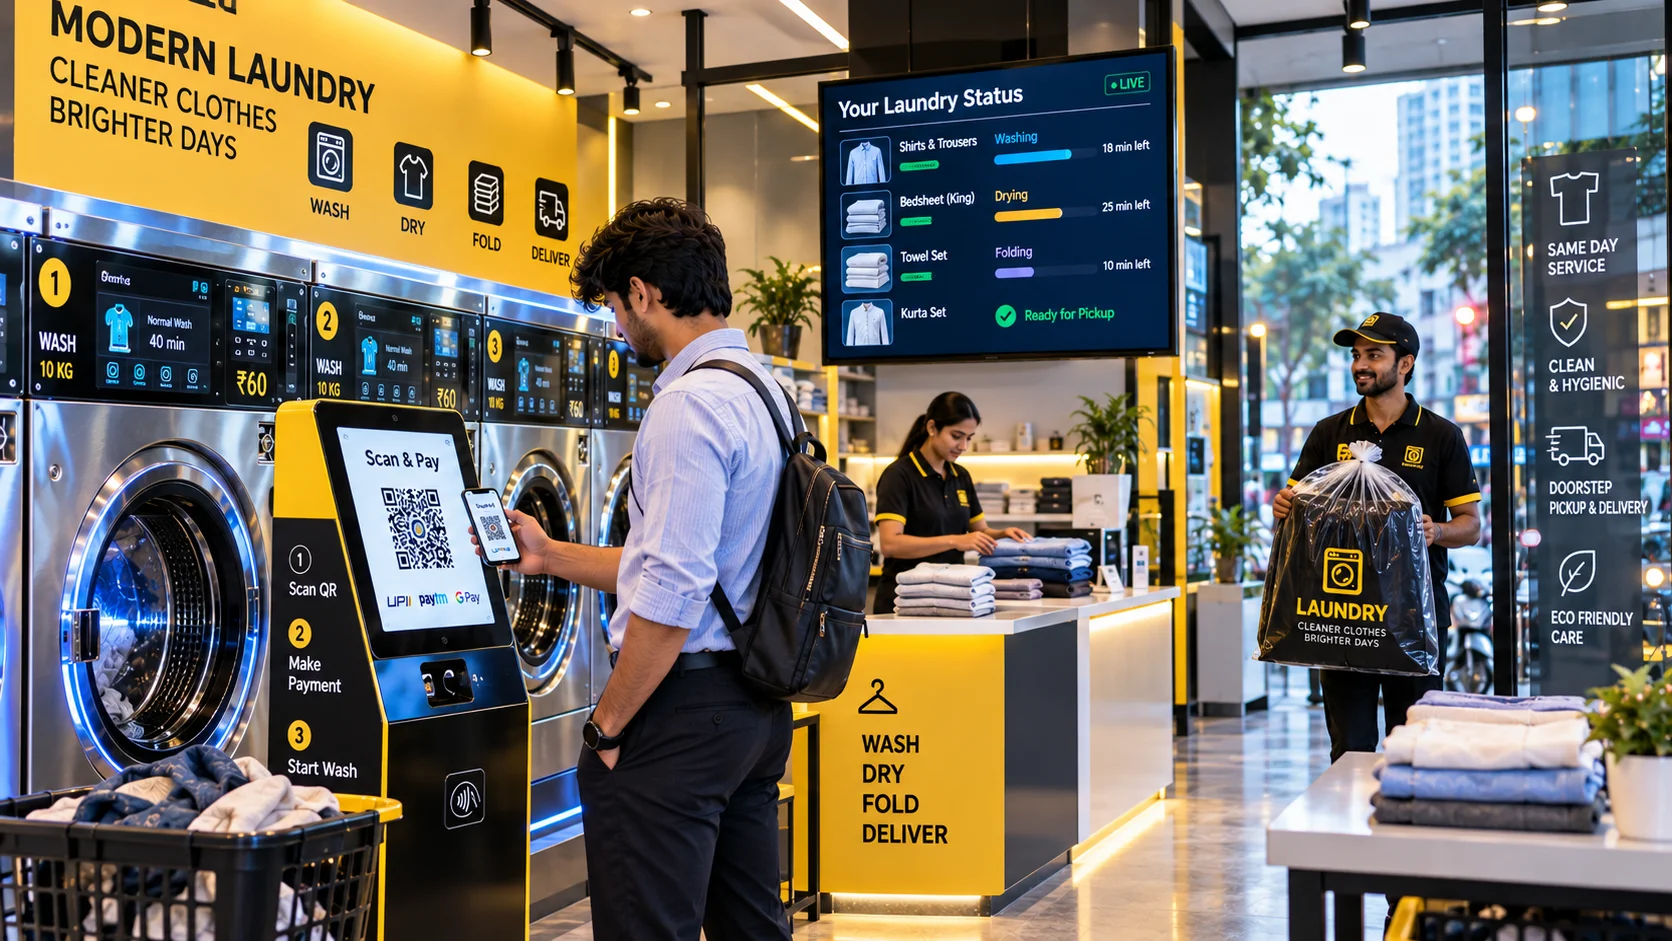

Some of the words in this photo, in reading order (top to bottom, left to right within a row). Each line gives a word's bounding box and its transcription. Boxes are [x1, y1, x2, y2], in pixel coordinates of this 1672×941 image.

[52, 0, 215, 76] MODERN
[230, 46, 375, 114] LAUNDRY
[1120, 77, 1145, 89] LIVE
[50, 56, 167, 108] CLEANER
[177, 87, 277, 133] CLOTHES
[838, 100, 879, 118] Your
[884, 91, 959, 114] Laundry
[963, 86, 1024, 108] Status
[50, 96, 172, 147] BRIGHTER
[181, 125, 237, 160] DAYS
[899, 140, 926, 153] Shirts
[928, 139, 936, 149] &
[937, 136, 978, 149] Trousers
[995, 131, 1038, 146] Washing
[1102, 142, 1113, 153] 18
[1115, 141, 1133, 153] min
[1134, 139, 1151, 151] left
[900, 194, 944, 208] Bedsheet
[946, 191, 976, 206] (King)
[995, 189, 1029, 204] Drying
[310, 197, 349, 220] WASH
[1102, 201, 1113, 212] 25
[1115, 201, 1133, 211] min
[1134, 199, 1151, 210] left
[401, 216, 426, 236] DRY
[472, 233, 501, 252] FOLD
[1548, 240, 1586, 257] SAME
[1591, 238, 1619, 254] DAY
[532, 246, 571, 267] DELIVER
[900, 250, 928, 262] Towel
[931, 249, 948, 261] Set
[995, 246, 1033, 260] Folding
[1103, 260, 1113, 271] 10
[1116, 260, 1133, 271] min
[1134, 258, 1151, 269] left
[1548, 258, 1605, 276] SERVICE
[901, 307, 928, 319] Kurta
[929, 306, 947, 318] Set
[1025, 309, 1058, 323] Ready
[1060, 308, 1076, 320] for
[1078, 307, 1115, 321] Pickup
[147, 315, 173, 327] Normal
[173, 316, 193, 330] Wash
[39, 331, 77, 354] WASH
[149, 334, 163, 348] 40
[166, 336, 185, 350] min
[40, 361, 55, 379] 10
[57, 362, 73, 380] KG
[316, 358, 343, 376] WASH
[387, 359, 396, 371] 40
[1549, 358, 1595, 374] CLEAN
[236, 370, 268, 397] ₹60
[317, 382, 327, 396] 10
[328, 383, 341, 397] KG
[1549, 378, 1559, 392] &
[1562, 376, 1626, 392] HYGIENIC
[437, 388, 456, 408] ₹60
[365, 449, 399, 467] Scan
[403, 451, 413, 467] &
[415, 453, 440, 473] Pay
[1549, 480, 1613, 495] DOORSTEP
[1549, 501, 1587, 515] PICKUP
[1588, 502, 1597, 514] &
[1599, 500, 1648, 514] DELIVERY
[288, 581, 317, 597] Scan
[319, 583, 337, 598] QR
[418, 592, 449, 608] paytm
[1296, 597, 1389, 623] LAUNDRY
[1551, 610, 1576, 625] ECO
[1578, 611, 1634, 626] FRIENDLY
[1297, 621, 1341, 634] CLEANER
[1343, 626, 1387, 638] CLOTHES
[1551, 630, 1583, 645] CARE
[1304, 634, 1352, 646] BRIGHTER
[1354, 638, 1380, 648] DAYS
[288, 656, 321, 672] Make
[288, 676, 342, 695] Payment
[862, 734, 919, 753] WASH
[287, 759, 319, 776] Start
[322, 761, 358, 779] Wash
[863, 764, 905, 784] DRY
[863, 793, 919, 814] FOLD
[863, 824, 949, 844] DELIVER
